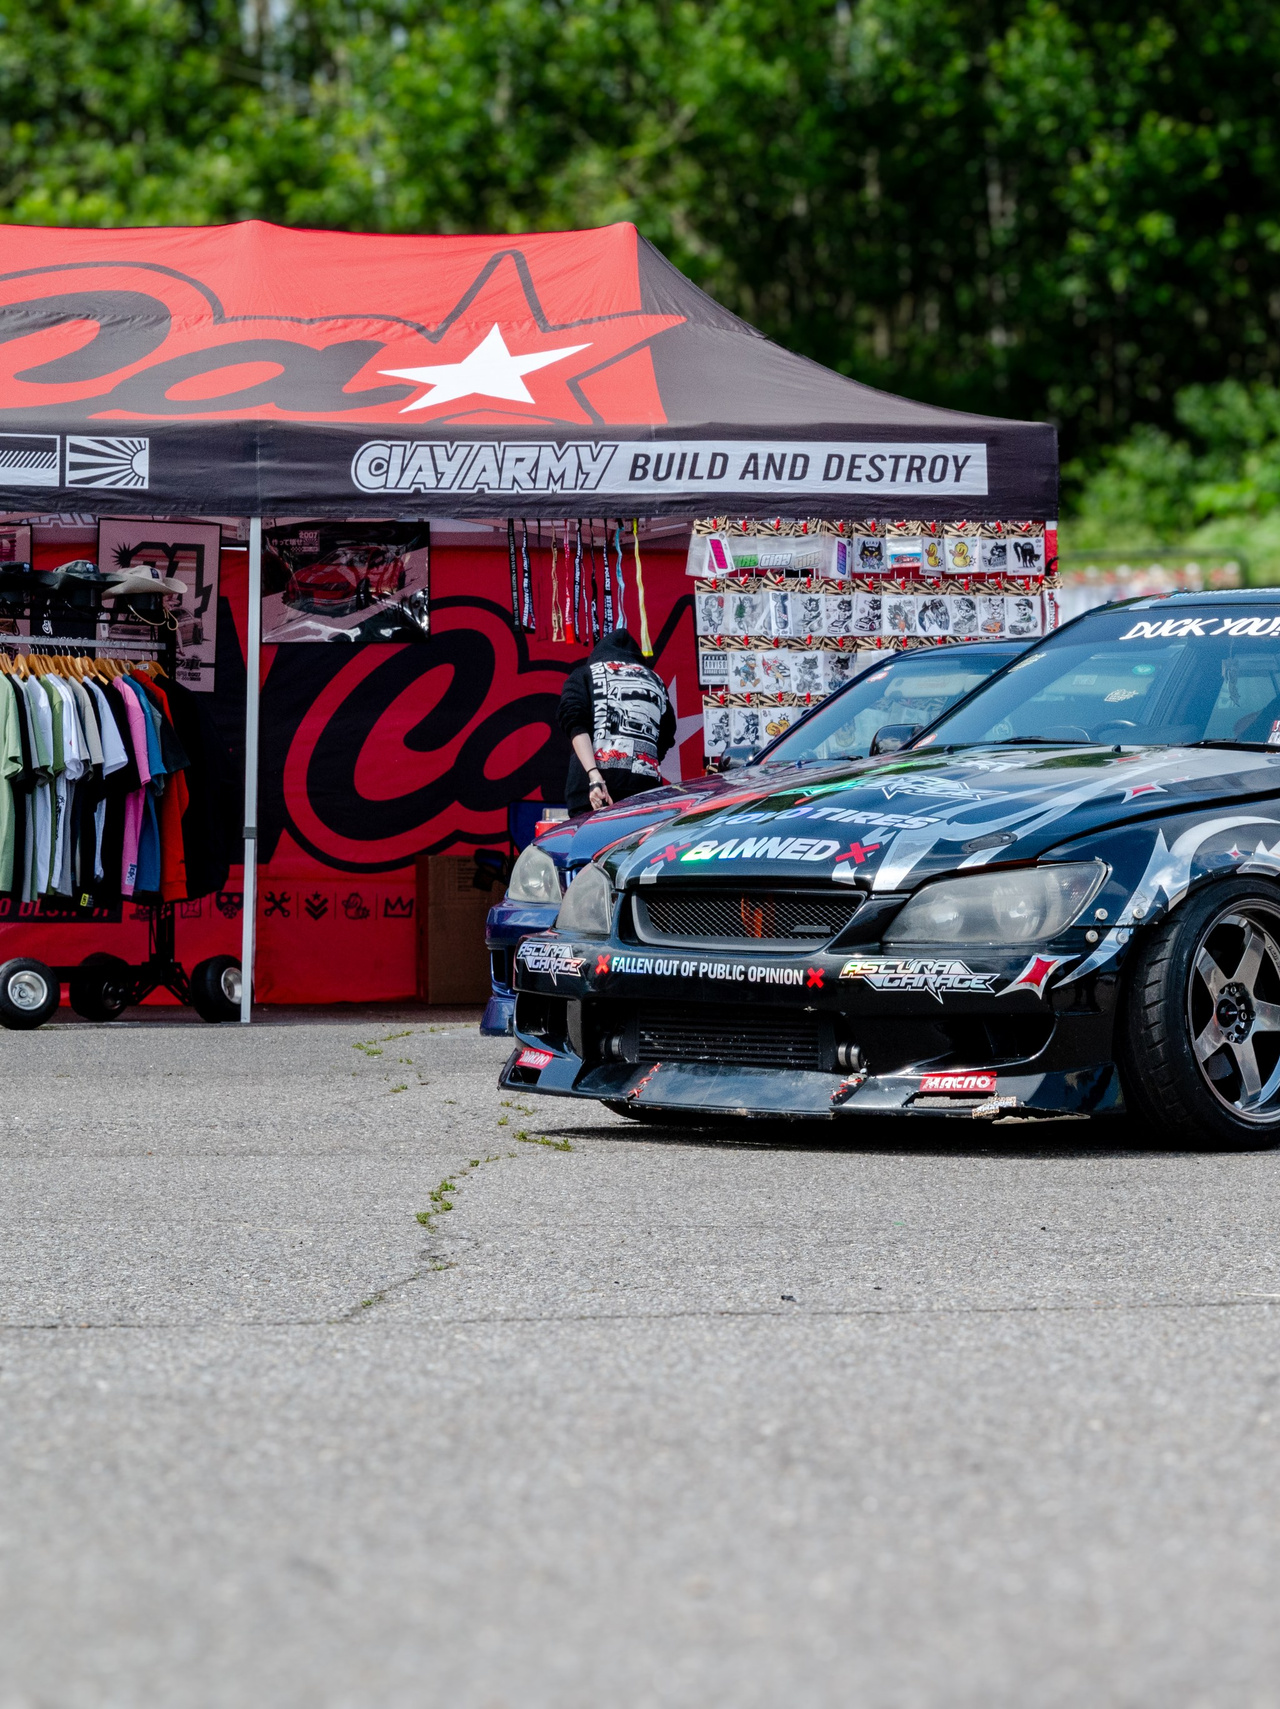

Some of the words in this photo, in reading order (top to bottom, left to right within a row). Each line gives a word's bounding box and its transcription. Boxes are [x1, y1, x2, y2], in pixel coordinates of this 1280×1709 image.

[629, 451, 729, 482] BUILD
[739, 451, 811, 482] AND
[822, 452, 972, 484] DESTROY
[1120, 617, 1219, 640] DUCK
[704, 660, 728, 668] ADVISO
[590, 662, 608, 695] DRIFT
[806, 807, 943, 830] TIRES
[680, 836, 841, 862] BANNED
[531, 956, 582, 974] GARAGE
[611, 956, 653, 975] FALLEN
[655, 959, 679, 976] OUT
[681, 961, 697, 977] OF
[699, 963, 745, 981] PUBLIC
[747, 966, 804, 985] OPINION
[841, 959, 951, 976] ASCURA
[880, 974, 994, 991] GARAGE
